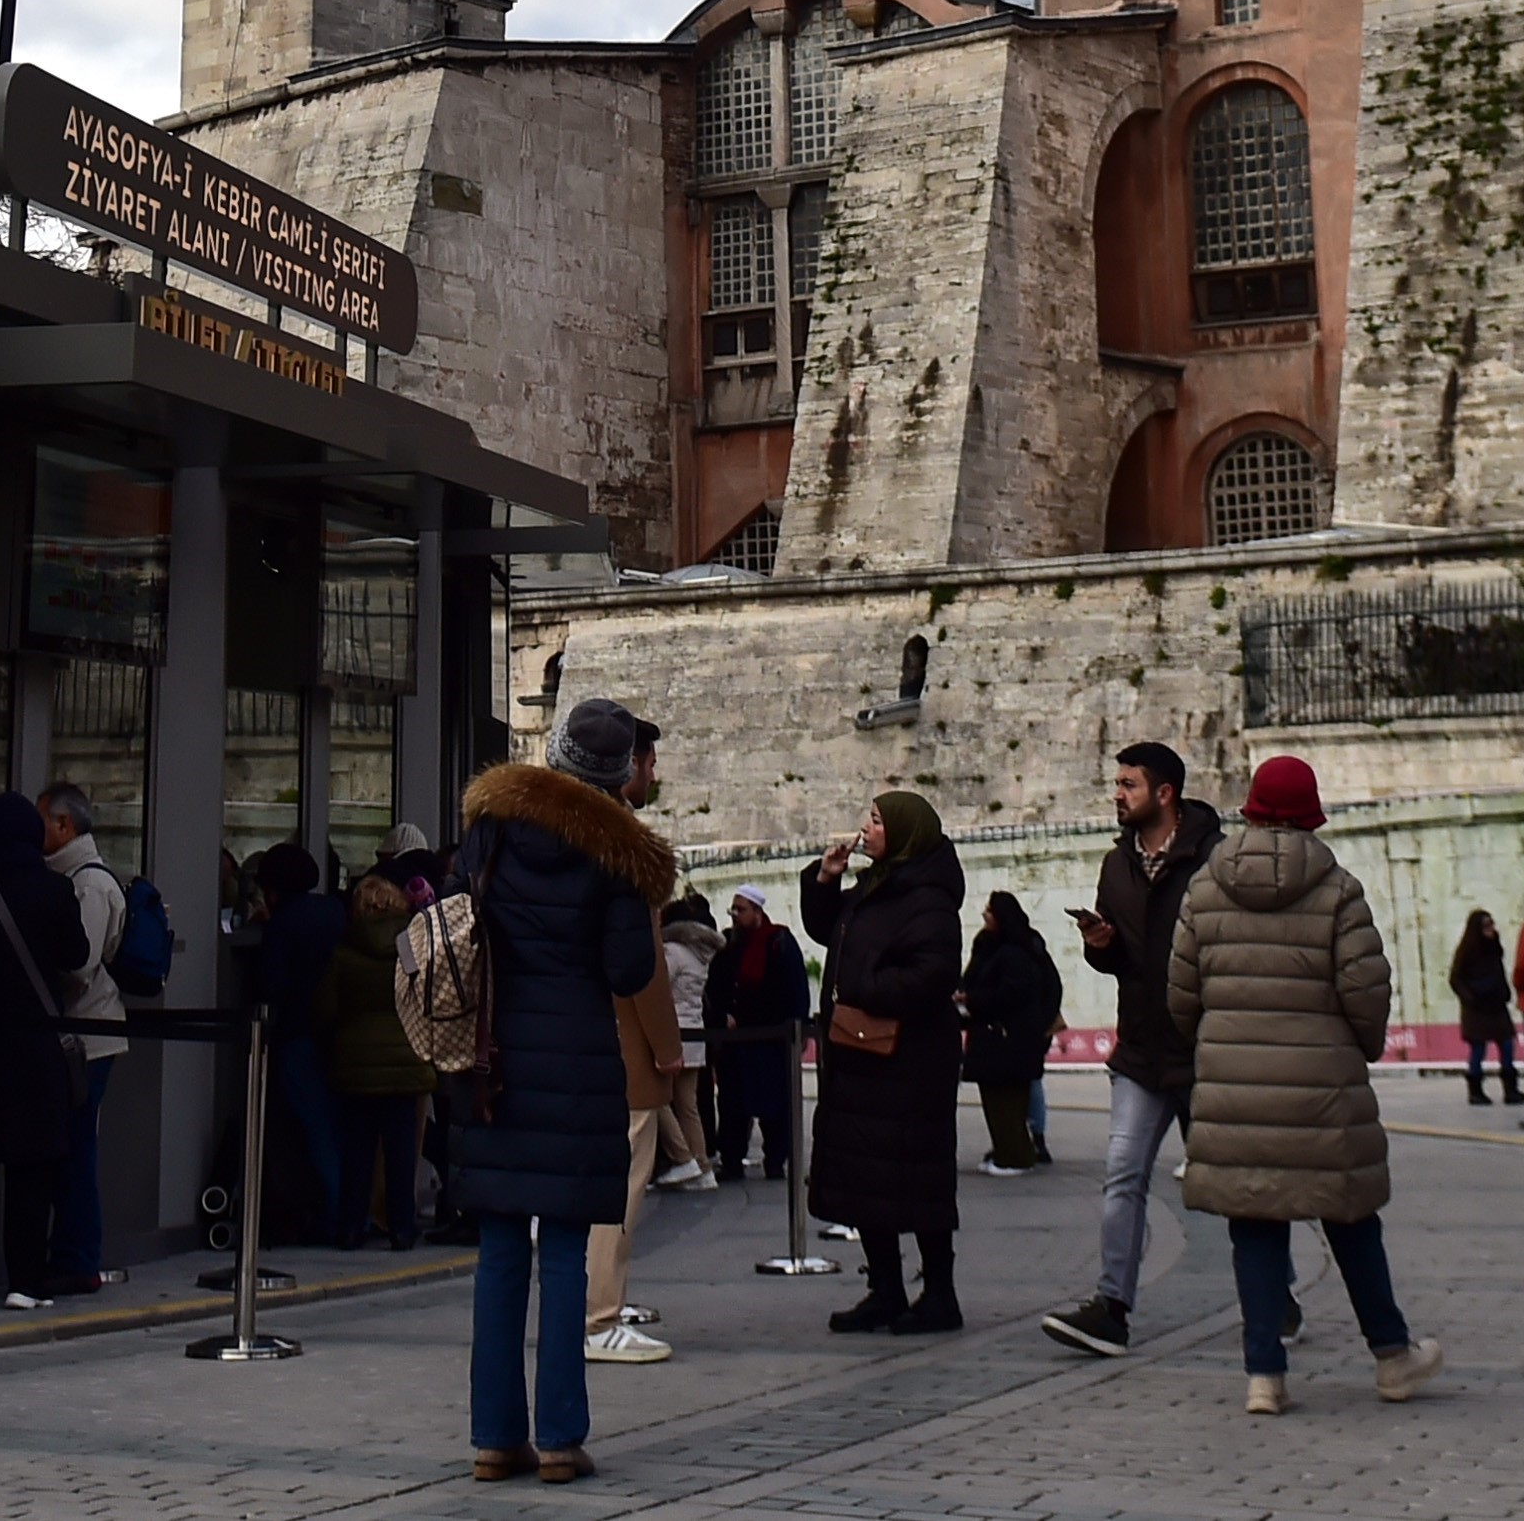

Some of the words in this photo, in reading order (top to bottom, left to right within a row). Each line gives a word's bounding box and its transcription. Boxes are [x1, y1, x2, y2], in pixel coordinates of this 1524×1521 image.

[63, 105, 193, 199] AYASOFYA-İ
[204, 172, 262, 232] KEBİR
[267, 206, 328, 263] CAMİ-İ
[332, 236, 386, 290] ŞERİFİ
[64, 157, 162, 236] ZİYARET
[167, 209, 230, 267] ALANI
[235, 238, 247, 275] /
[252, 245, 336, 312] VISITING
[339, 287, 380, 332] AREA
